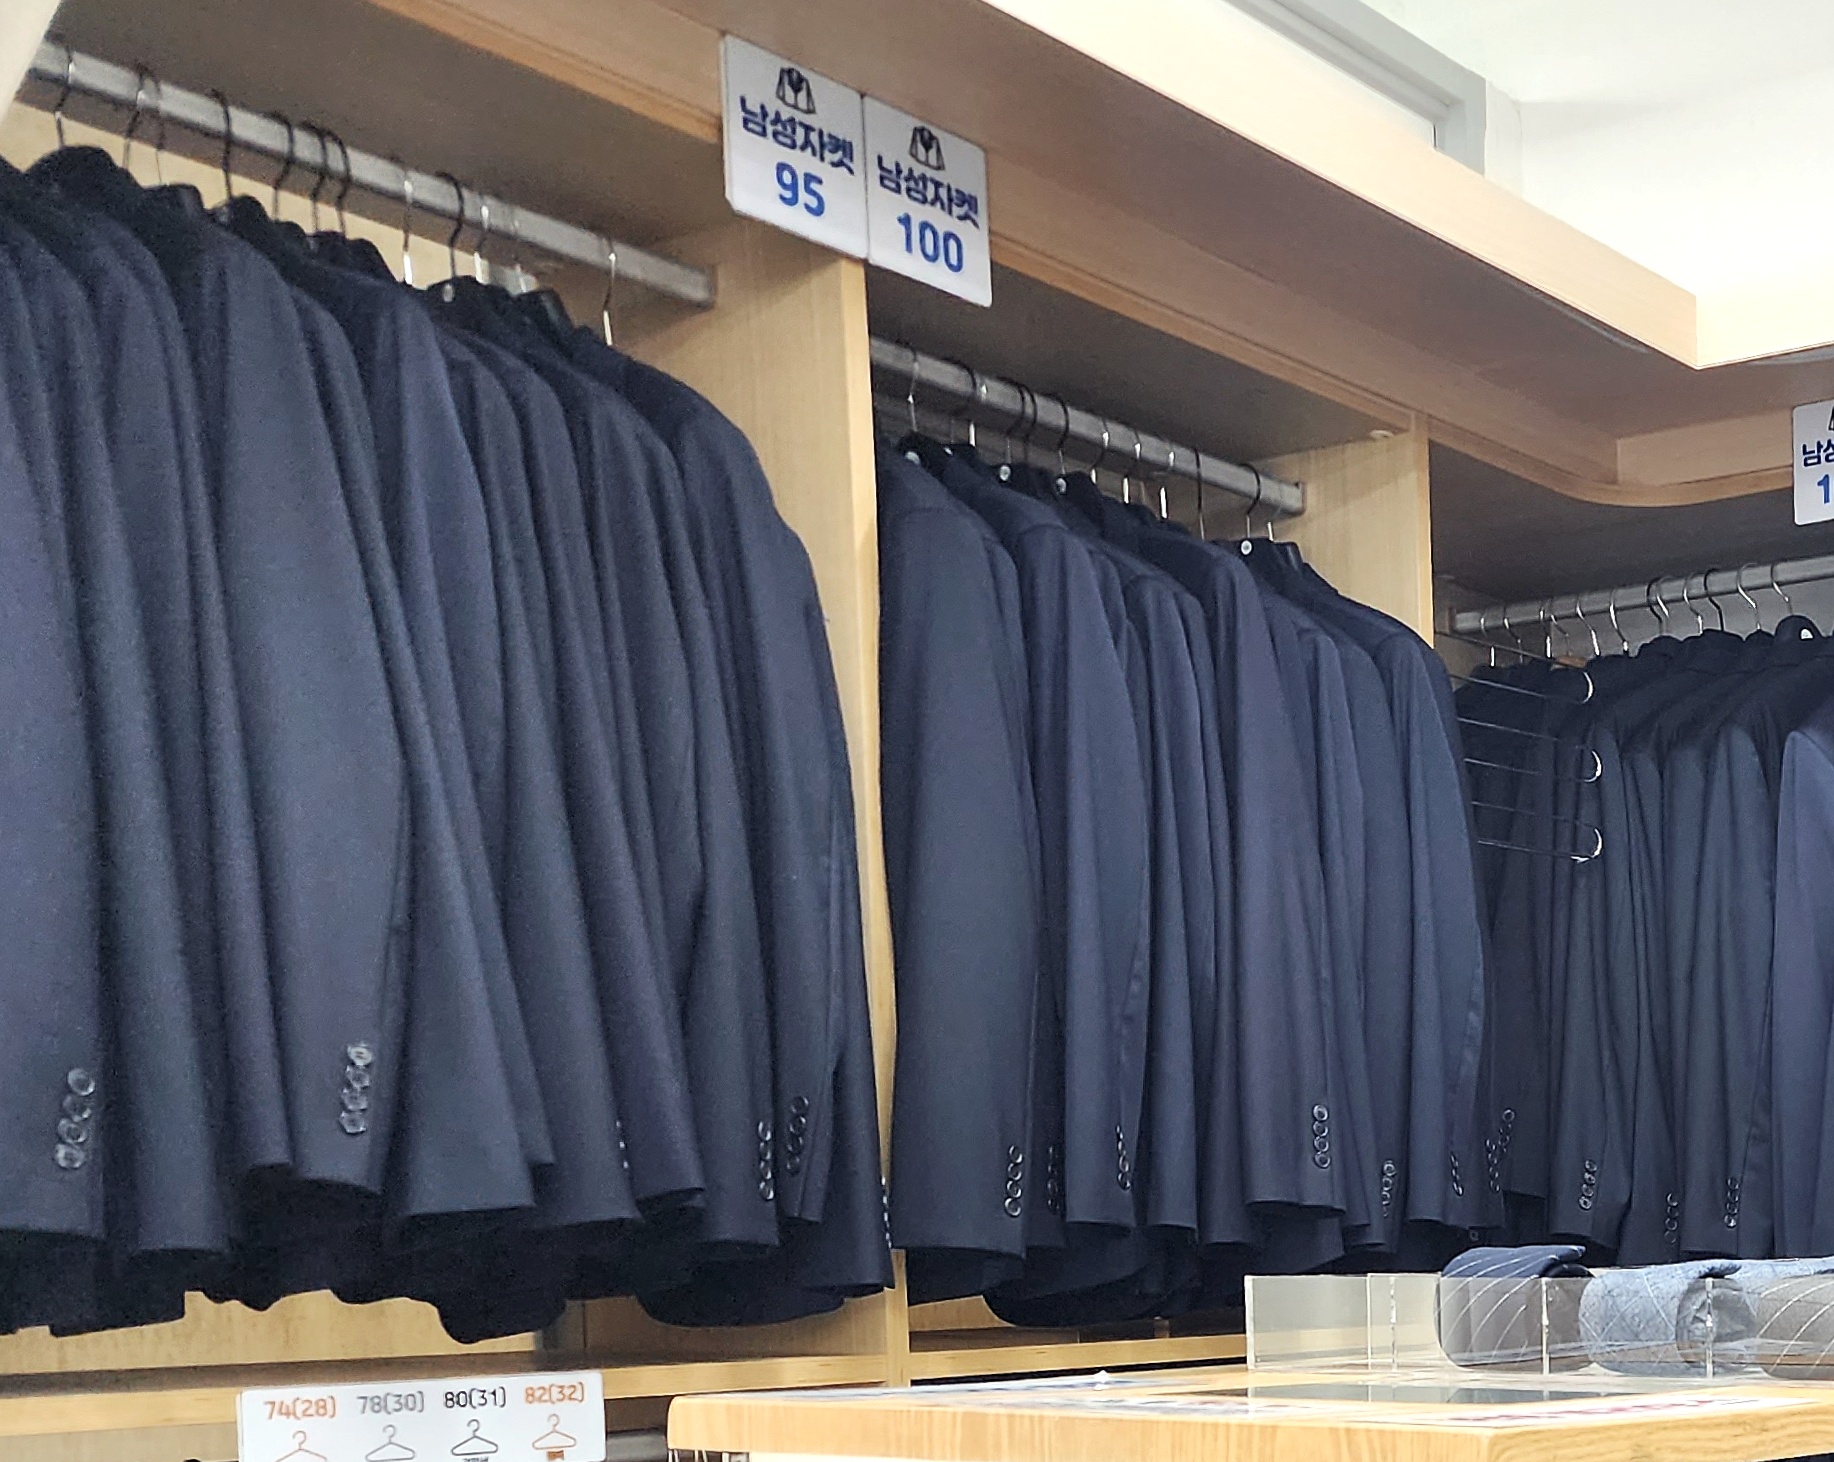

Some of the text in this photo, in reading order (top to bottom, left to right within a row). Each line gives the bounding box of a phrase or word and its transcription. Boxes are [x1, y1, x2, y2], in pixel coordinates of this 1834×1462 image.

[740, 96, 855, 176] 남성자켓
[776, 162, 825, 217] 95
[877, 154, 979, 229] 남성자켓
[897, 213, 964, 273] 100
[263, 1381, 585, 1420] 74(28) 78(30) 80(31) 82(32)
